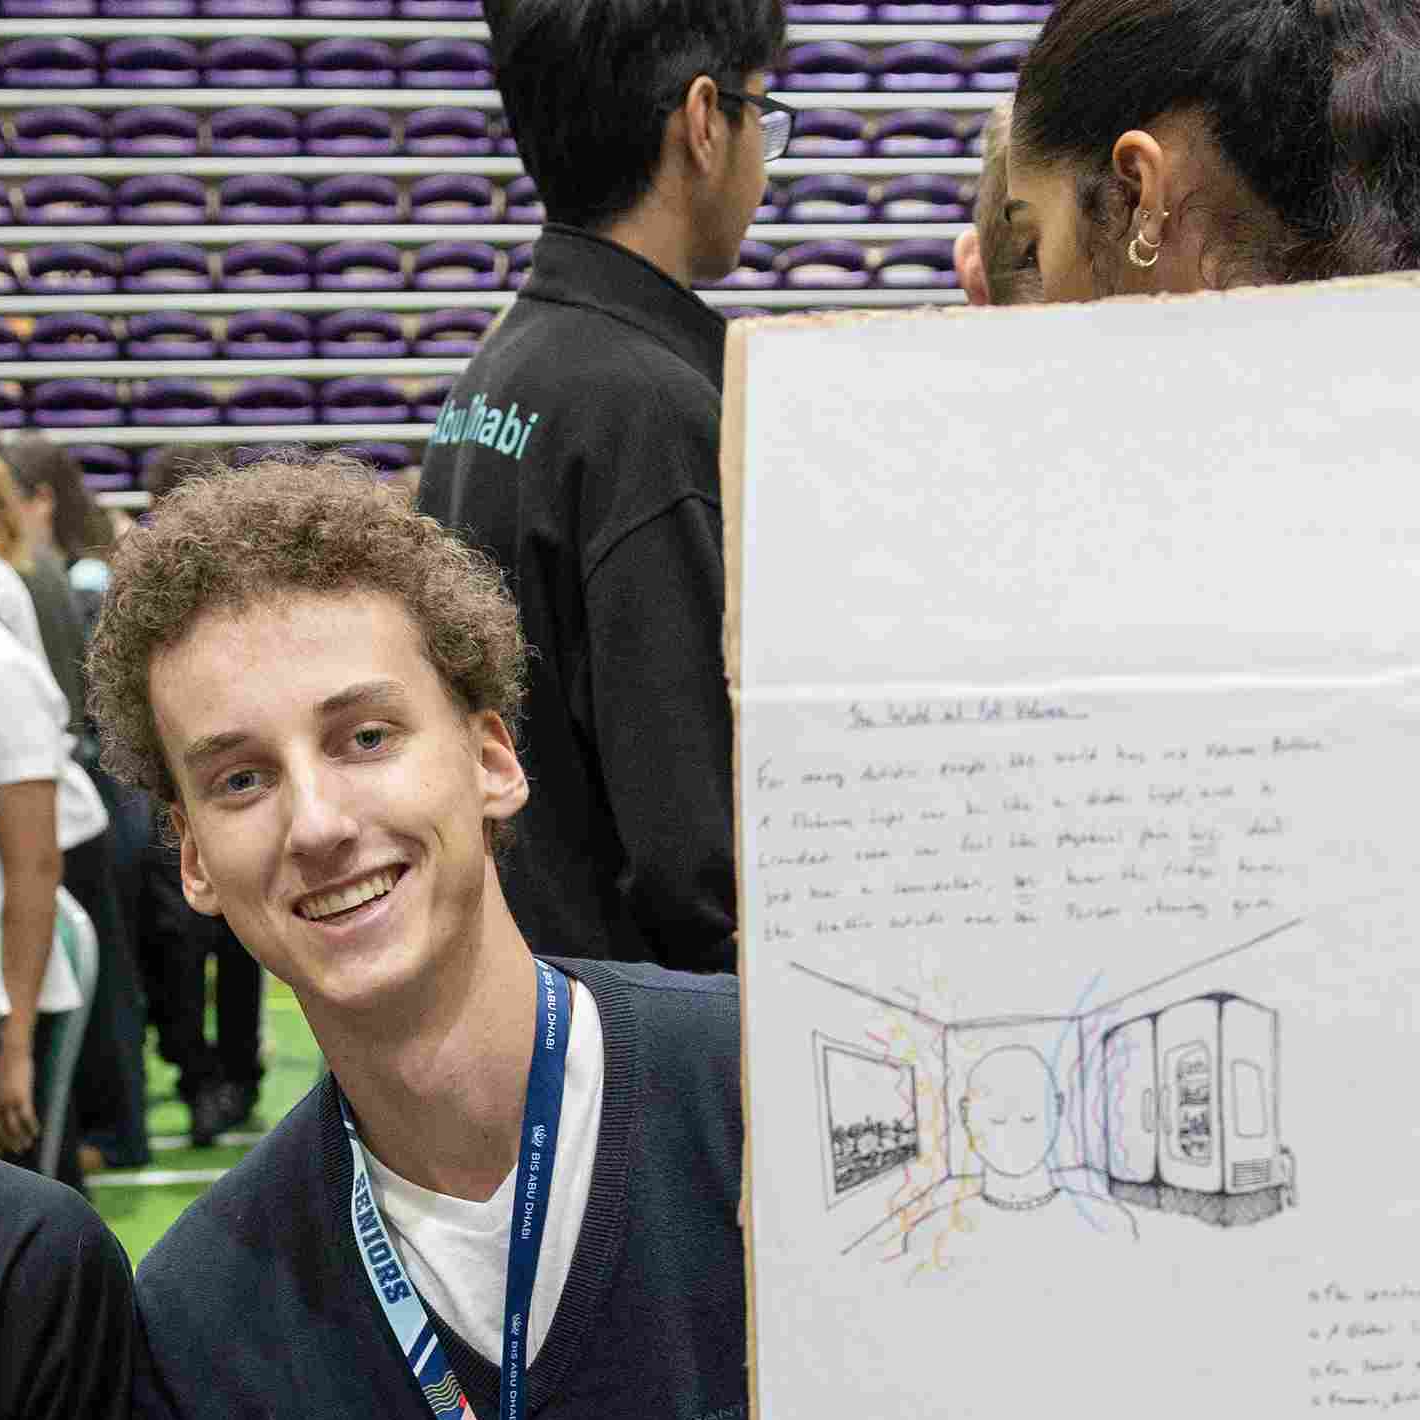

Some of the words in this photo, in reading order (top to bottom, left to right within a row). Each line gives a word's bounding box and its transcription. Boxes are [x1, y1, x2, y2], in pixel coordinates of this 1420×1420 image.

[546, 1012, 557, 1051] DHABI
[529, 1152, 541, 1175] BIS
[526, 1175, 538, 1200] ABU
[355, 1172, 412, 1305] SENIORS
